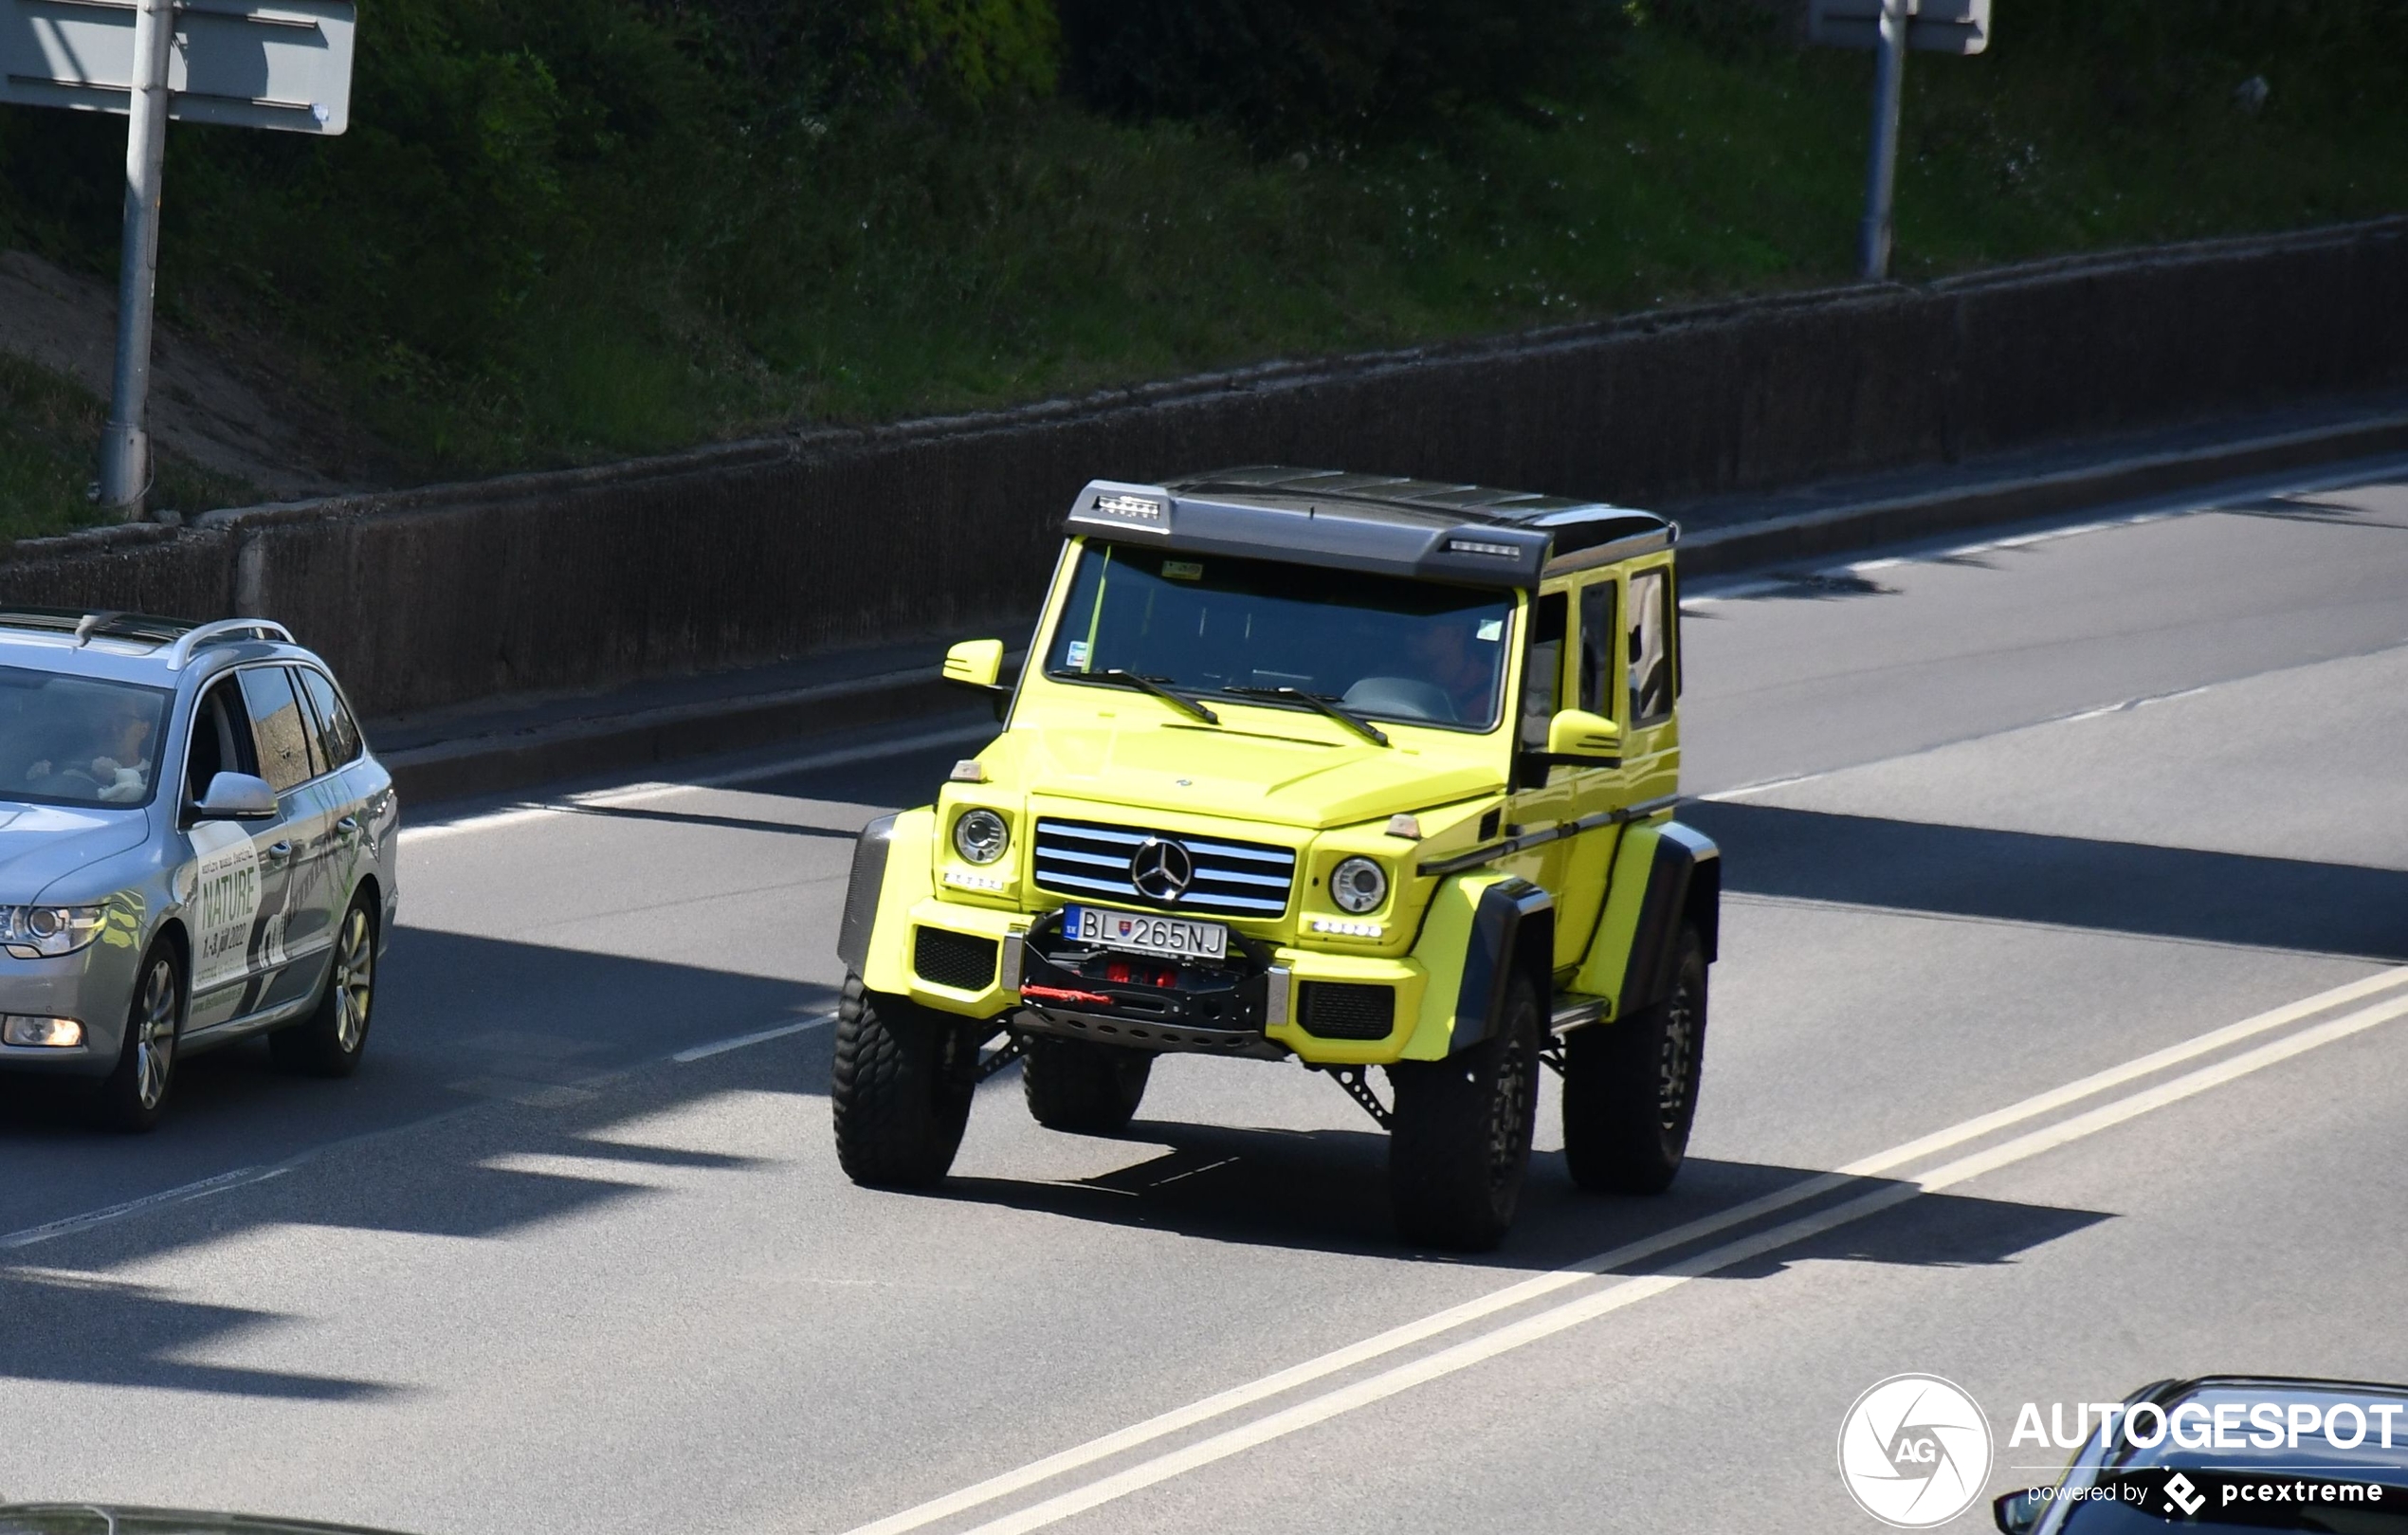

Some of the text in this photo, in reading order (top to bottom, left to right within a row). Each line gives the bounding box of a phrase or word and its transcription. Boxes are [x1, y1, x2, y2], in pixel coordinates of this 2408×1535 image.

[202, 867, 255, 930] NATURE
[1083, 911, 1116, 941] BL
[1133, 919, 1223, 954] 265NJ
